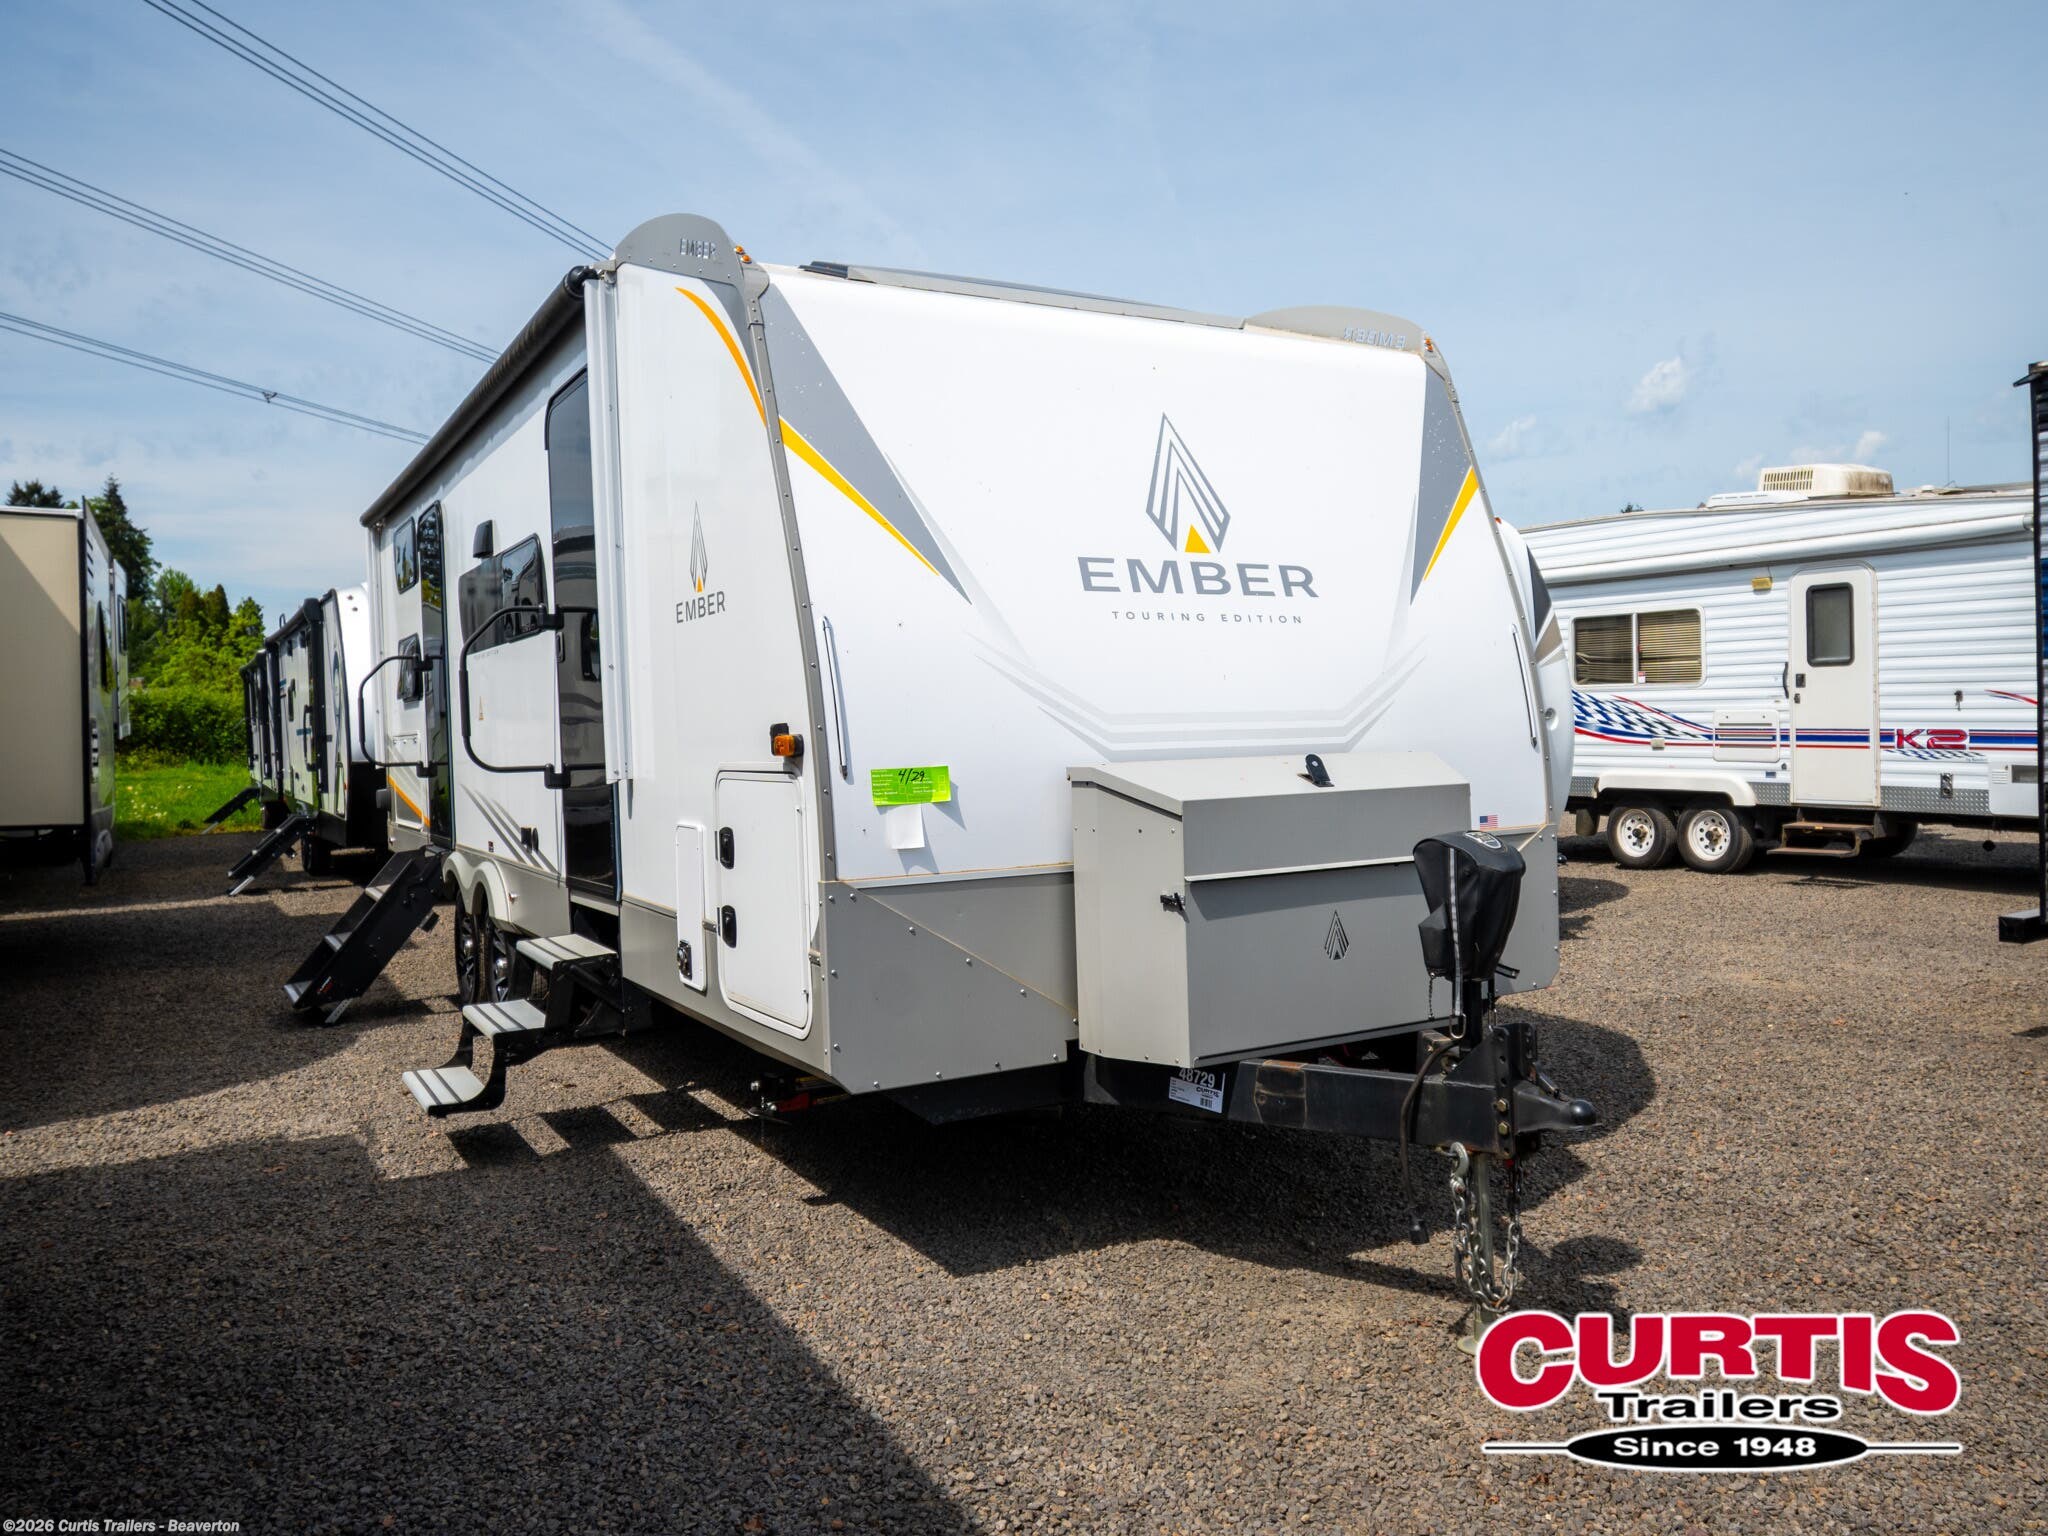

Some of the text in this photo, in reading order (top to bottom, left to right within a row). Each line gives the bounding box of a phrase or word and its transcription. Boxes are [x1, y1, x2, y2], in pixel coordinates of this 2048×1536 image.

[680, 238, 717, 259] EMBER
[1077, 556, 1319, 598] EMBER
[675, 591, 726, 624] EMBER
[1112, 611, 1303, 624] TOURING EDITION
[1896, 729, 1967, 750] K2
[898, 769, 925, 784] 4/29
[1179, 1068, 1216, 1089] 48729
